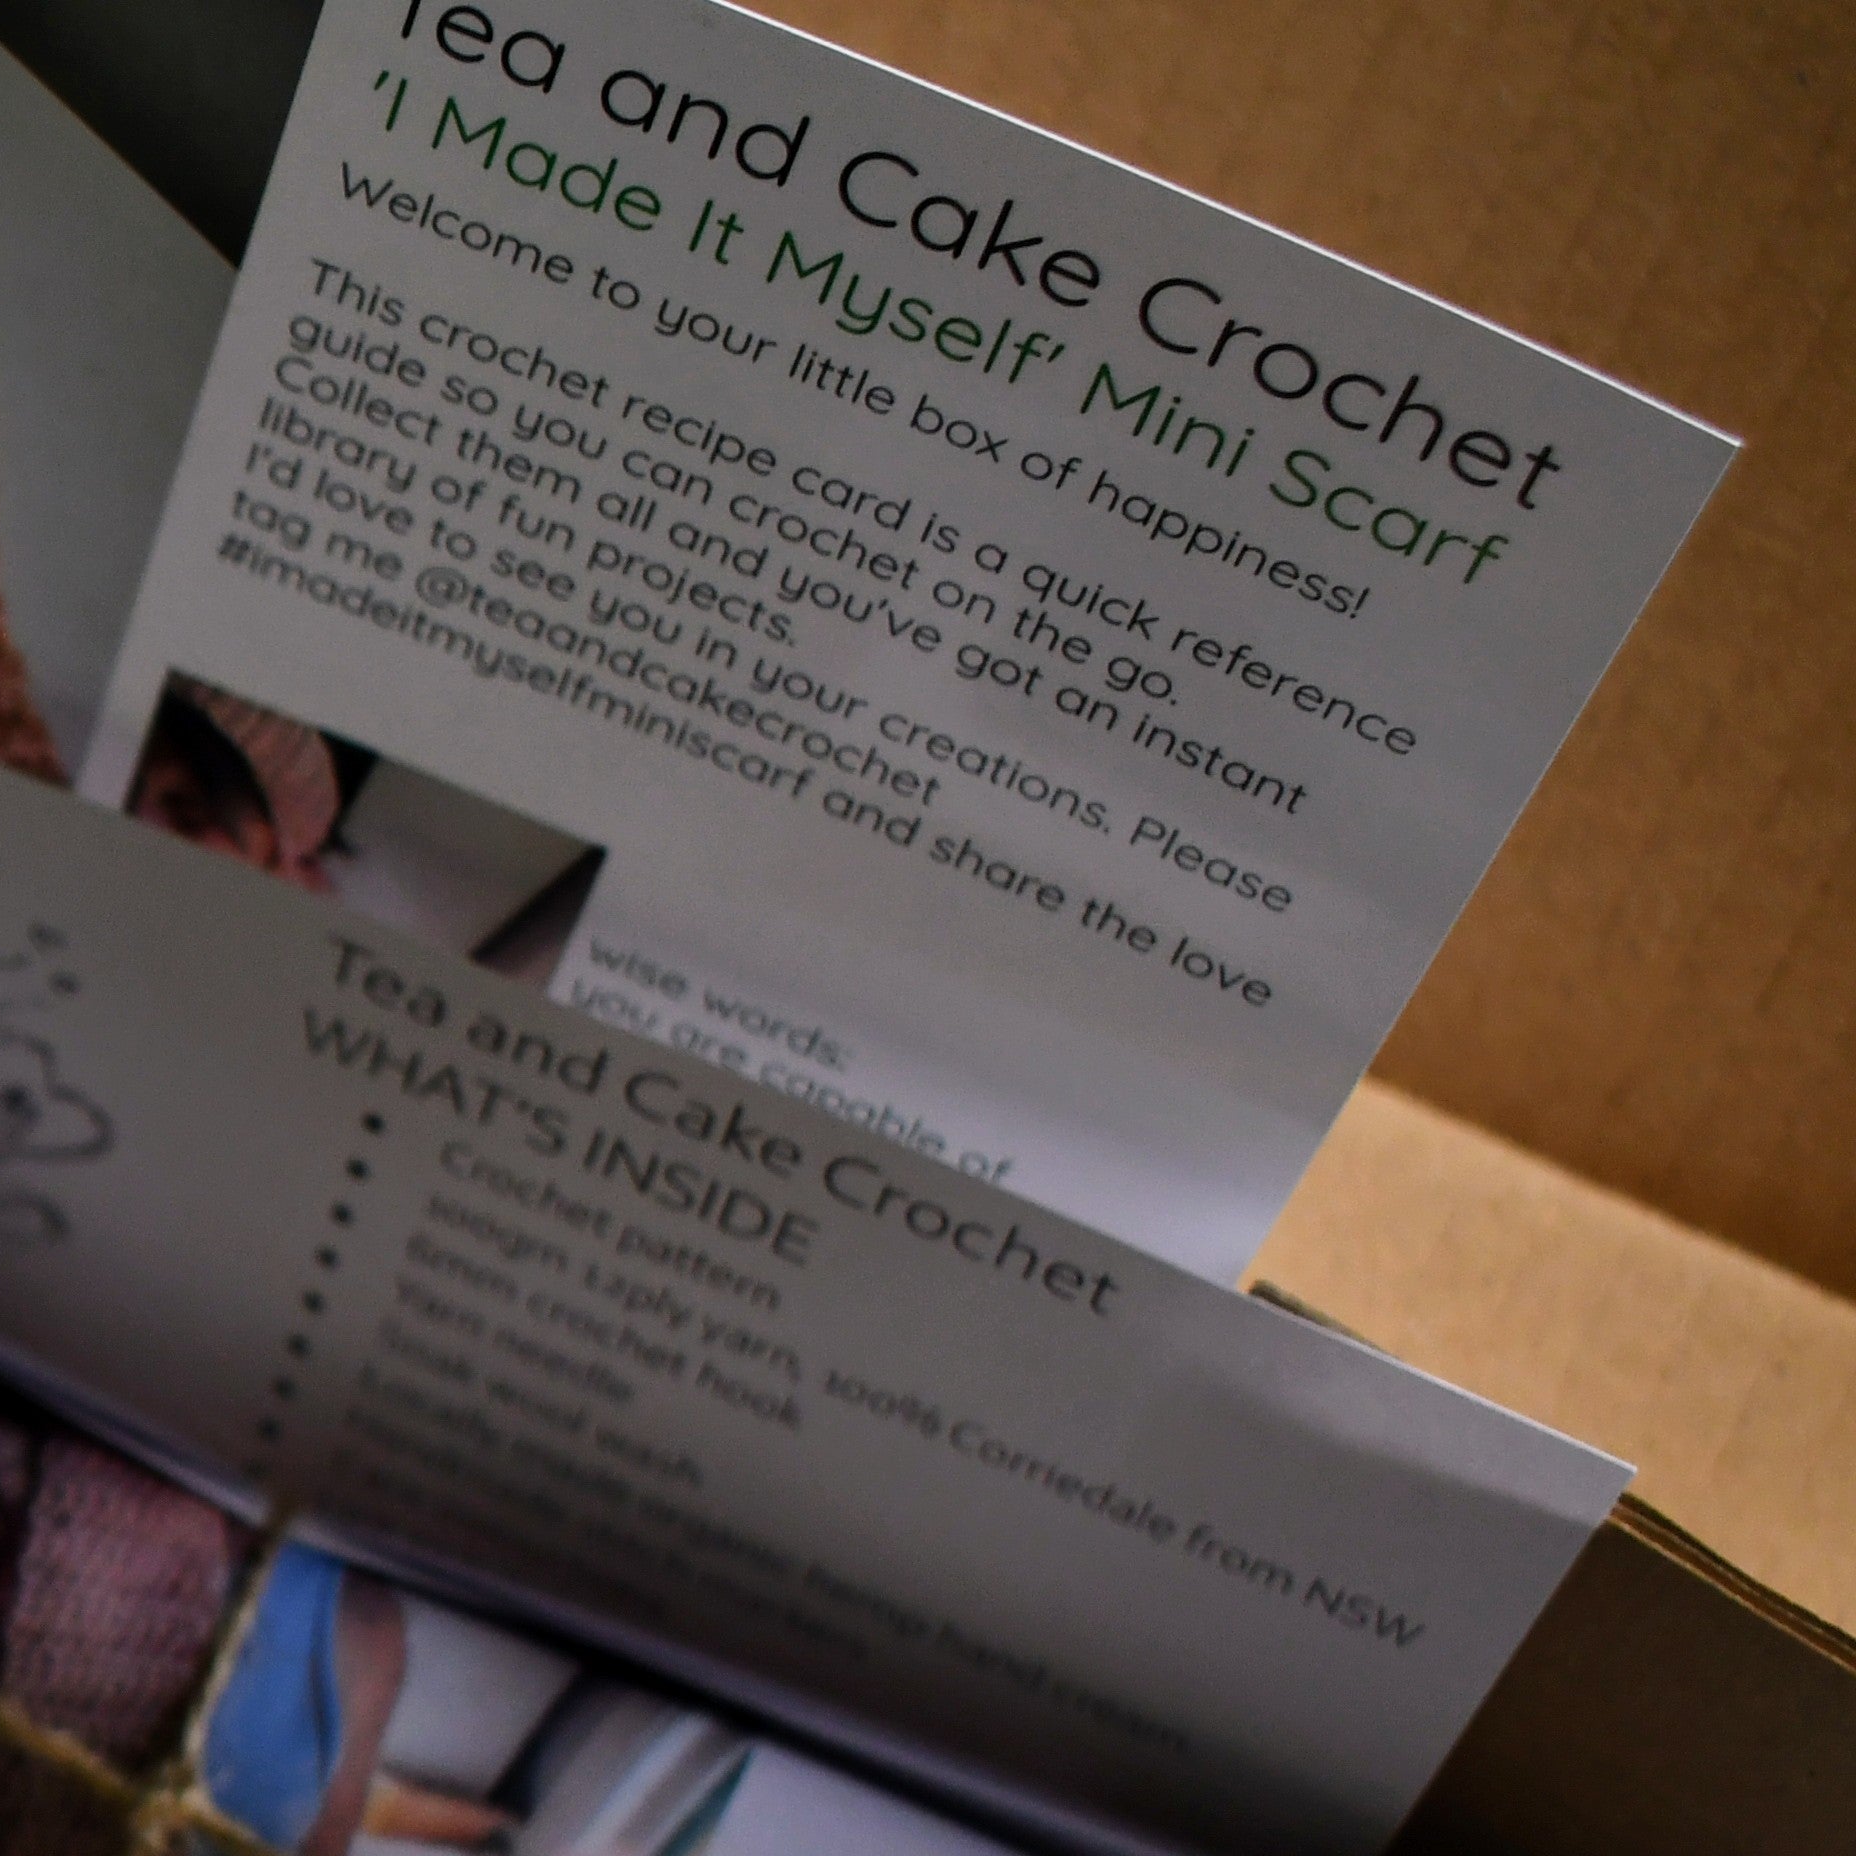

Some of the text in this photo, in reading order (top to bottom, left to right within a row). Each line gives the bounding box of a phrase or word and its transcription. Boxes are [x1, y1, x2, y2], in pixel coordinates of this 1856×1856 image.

[341, 161, 1371, 620] Welcome to your little box of happiness!
[431, 96, 662, 232] Made
[688, 198, 745, 266] It
[765, 230, 1066, 384] Myself'
[1079, 362, 1256, 478] Mini
[1268, 448, 1510, 585] Scarf
[600, 69, 812, 188] and
[837, 150, 1102, 308] Cake
[1138, 277, 1561, 511] Crochet
[232, 489, 941, 807] tag me @teaandcakecrochet
[258, 396, 795, 647] library of fun projects.
[274, 345, 1307, 815] Collect them all and you've got an instant
[288, 315, 1178, 707] guide so you can crochet on the go.
[311, 257, 1417, 756] This crochet recipe card is a quick reference
[313, 467, 416, 536] love
[429, 517, 478, 562] to
[490, 548, 577, 602] see
[589, 588, 683, 646] you
[694, 627, 739, 670] in
[750, 657, 868, 720] your
[878, 713, 1110, 835] creations.
[1129, 815, 1293, 913] Please
[589, 939, 689, 1000] wise
[822, 790, 922, 848] and
[929, 836, 1067, 912] share
[1080, 898, 1158, 954] the
[1169, 936, 1273, 1007] love
[303, 1008, 817, 1264] WHAT'S INSIDE
[330, 935, 1118, 1316] Tea and Cake Crochet
[438, 1140, 782, 1312] Crochet pattern
[525, 1293, 688, 1378] crochet
[695, 1360, 801, 1431] hook
[948, 1420, 1178, 1544] Corriedale
[1184, 1522, 1295, 1596] from
[1303, 1576, 1425, 1648] NSW
